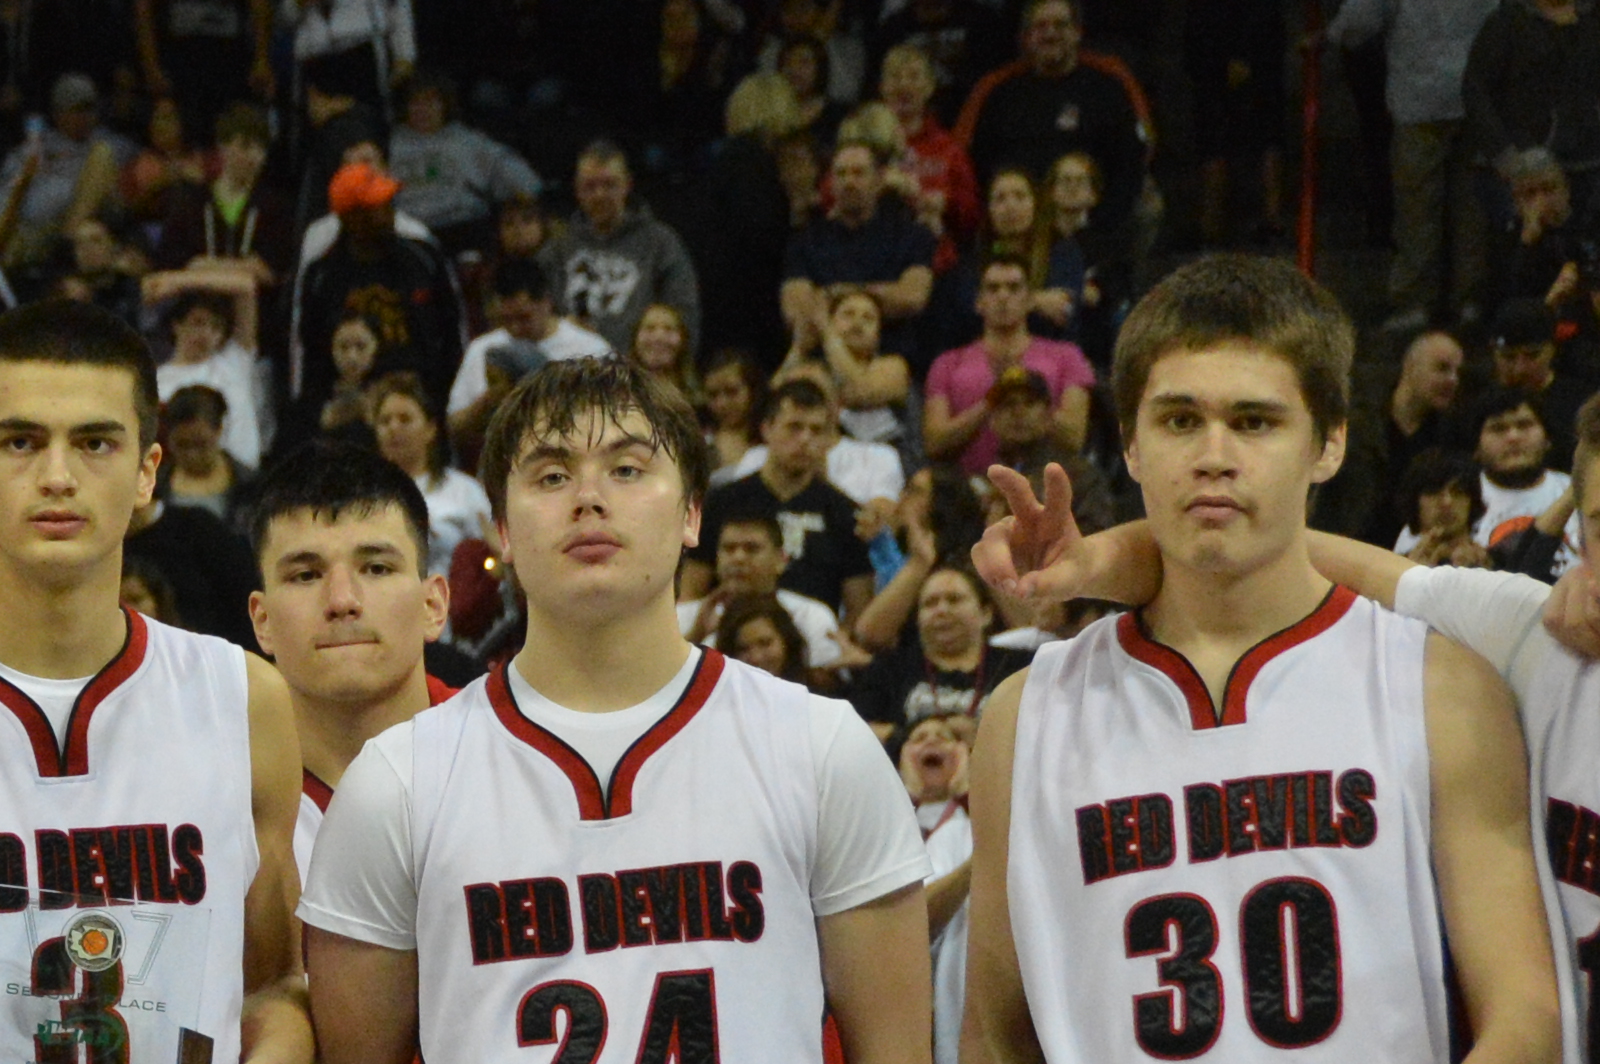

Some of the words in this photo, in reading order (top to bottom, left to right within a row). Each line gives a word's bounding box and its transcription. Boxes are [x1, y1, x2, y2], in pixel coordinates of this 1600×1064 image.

[34, 823, 207, 910] DEVILS
[1075, 792, 1177, 886] RED
[1183, 768, 1378, 864] DEVILS
[1547, 797, 1600, 896] RE
[463, 876, 574, 966] RED
[577, 860, 765, 955] DEVILS
[1123, 875, 1343, 1061] 30
